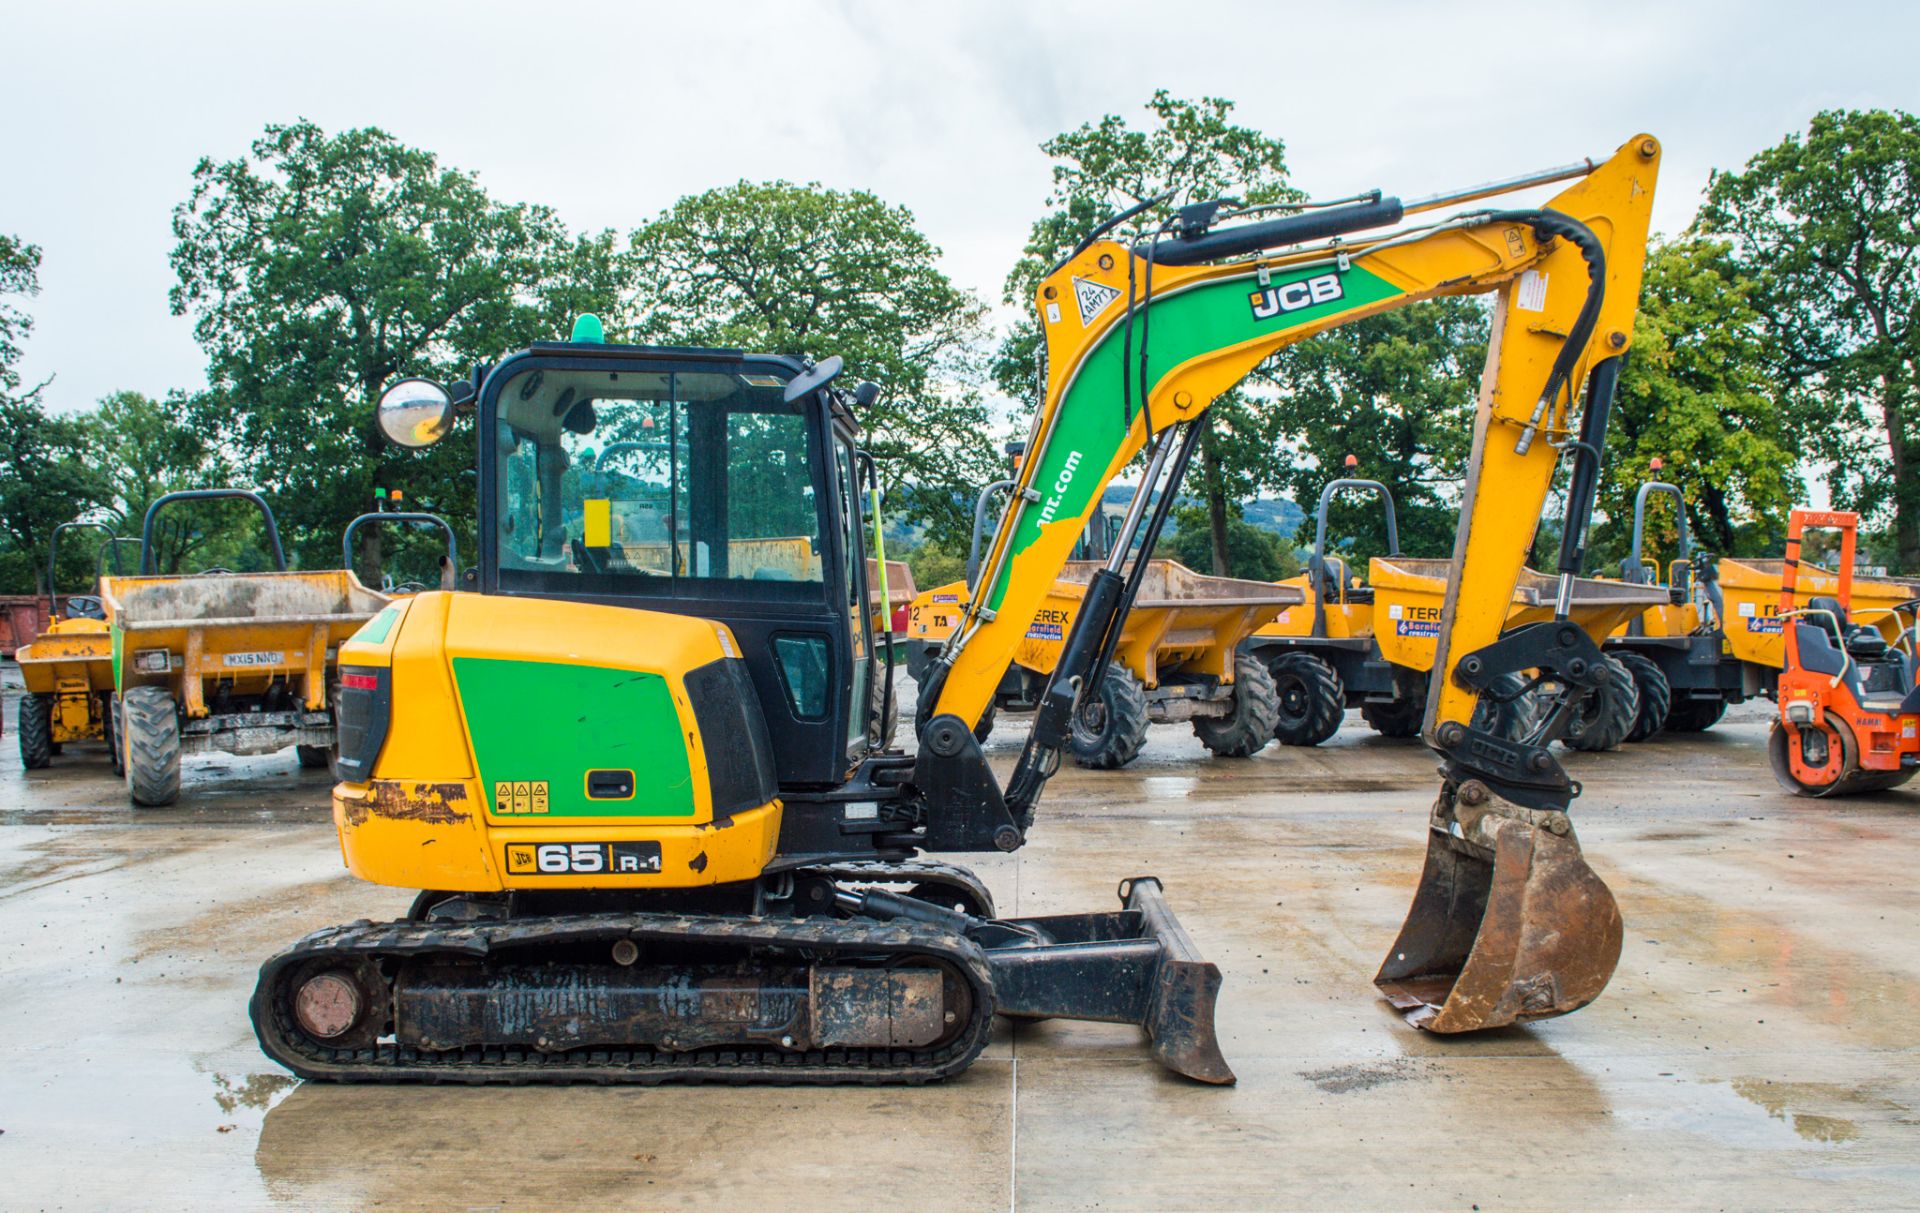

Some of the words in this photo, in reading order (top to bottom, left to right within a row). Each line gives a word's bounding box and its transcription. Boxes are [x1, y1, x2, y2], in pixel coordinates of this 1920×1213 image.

[1082, 287, 1096, 301] 24
[1254, 274, 1342, 317] JCB
[909, 606, 920, 621] 12
[1030, 624, 1061, 633] arnfield
[537, 844, 603, 872] 65
